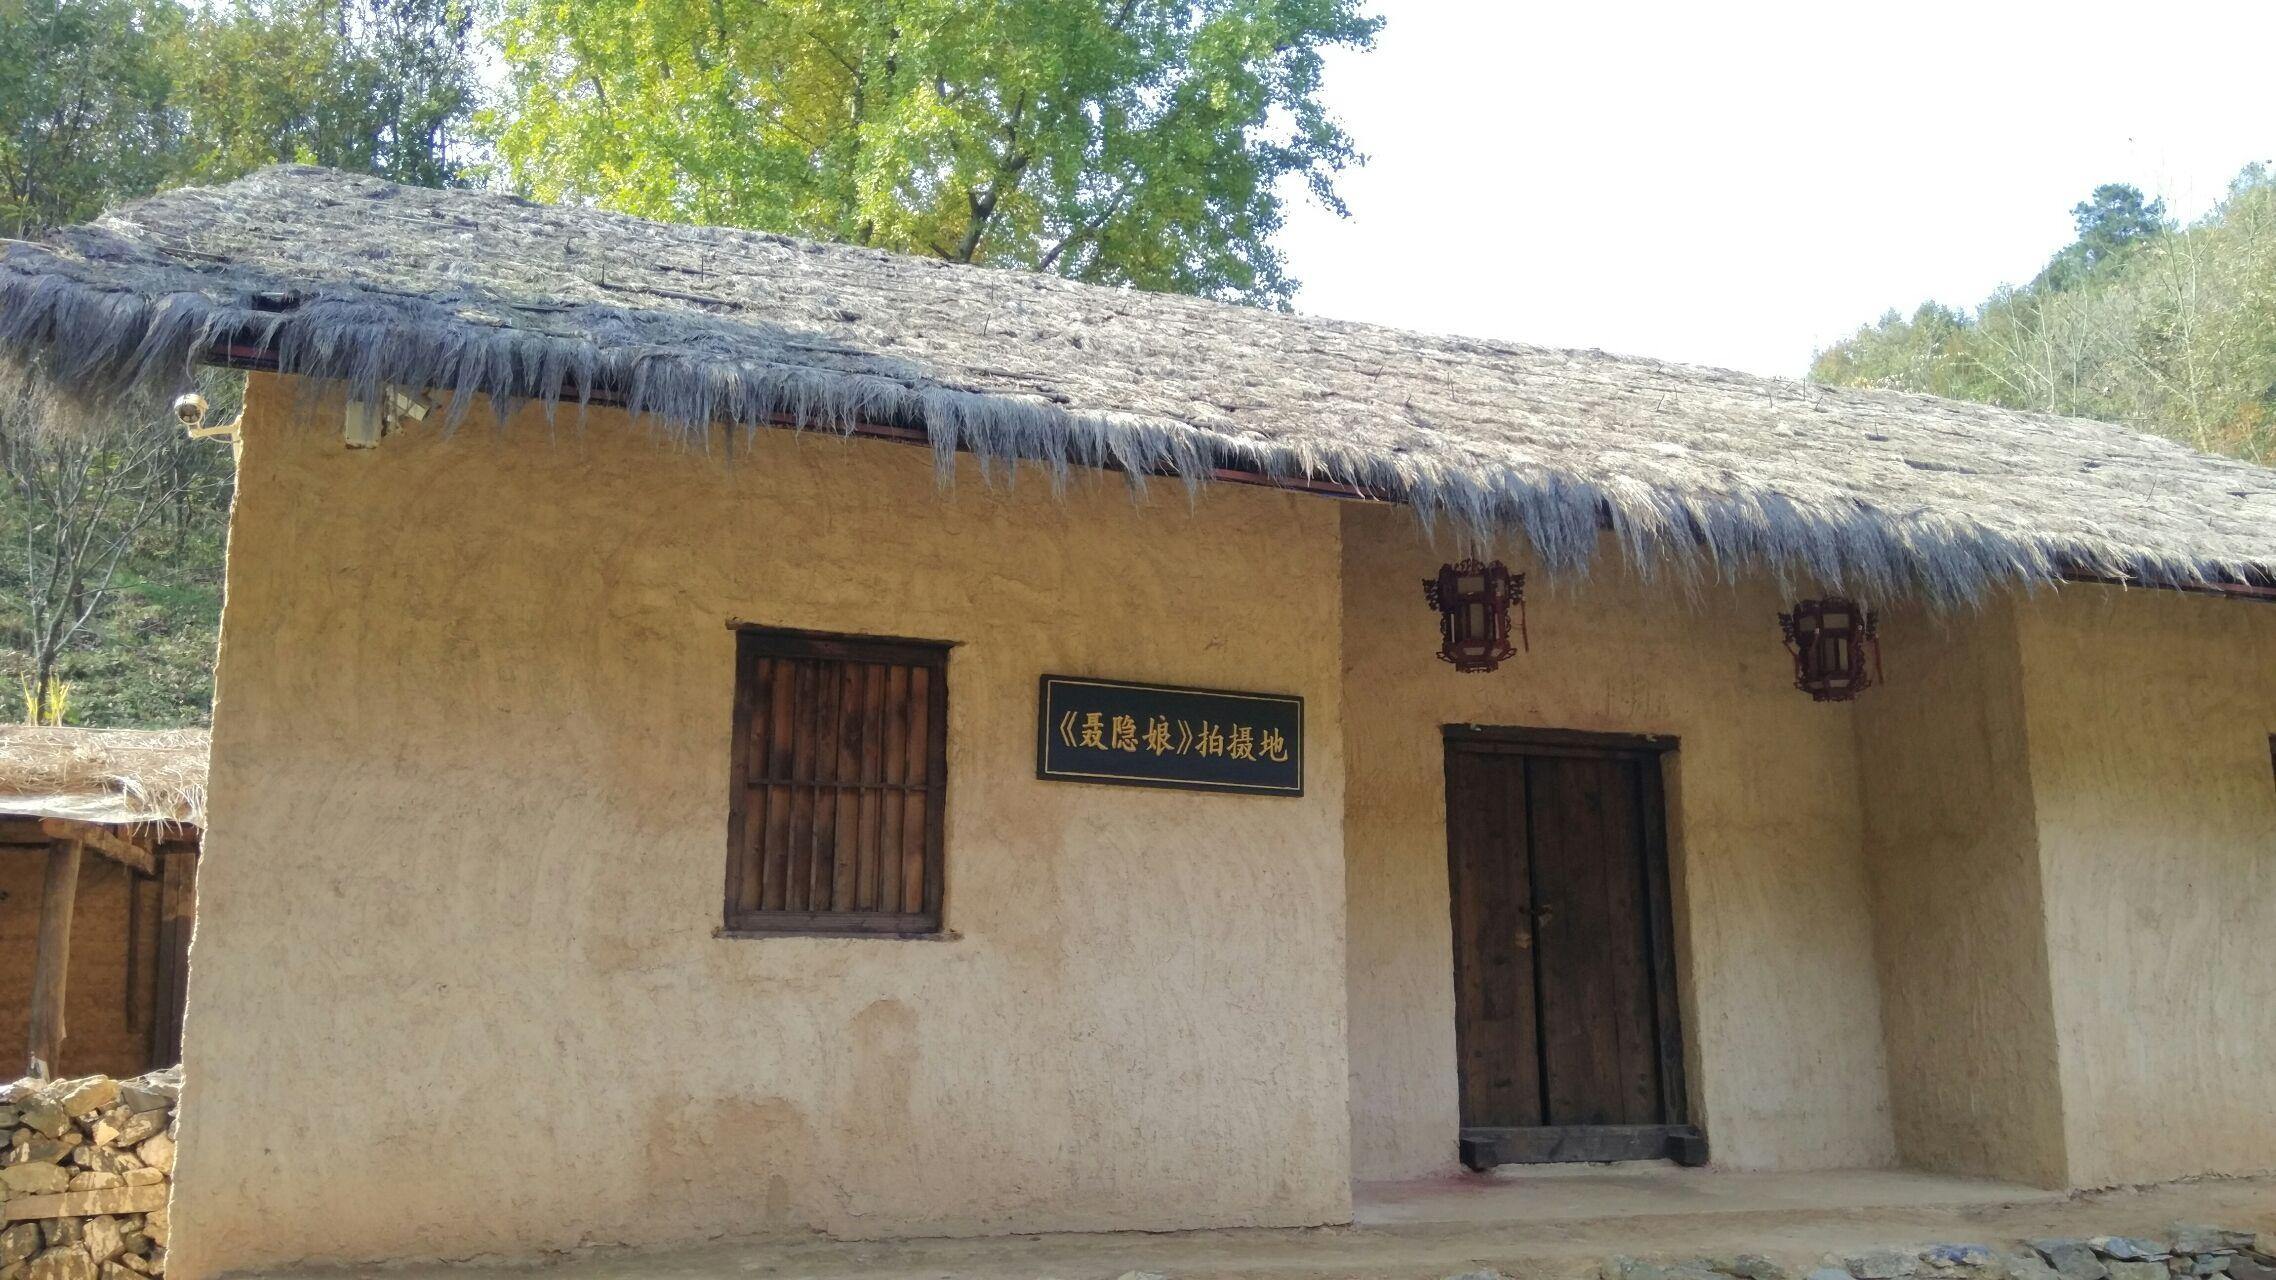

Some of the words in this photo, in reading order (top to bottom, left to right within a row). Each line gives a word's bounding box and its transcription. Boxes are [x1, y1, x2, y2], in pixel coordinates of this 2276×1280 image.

[1060, 711, 1288, 762] 《聂隐娘》拍摄地
